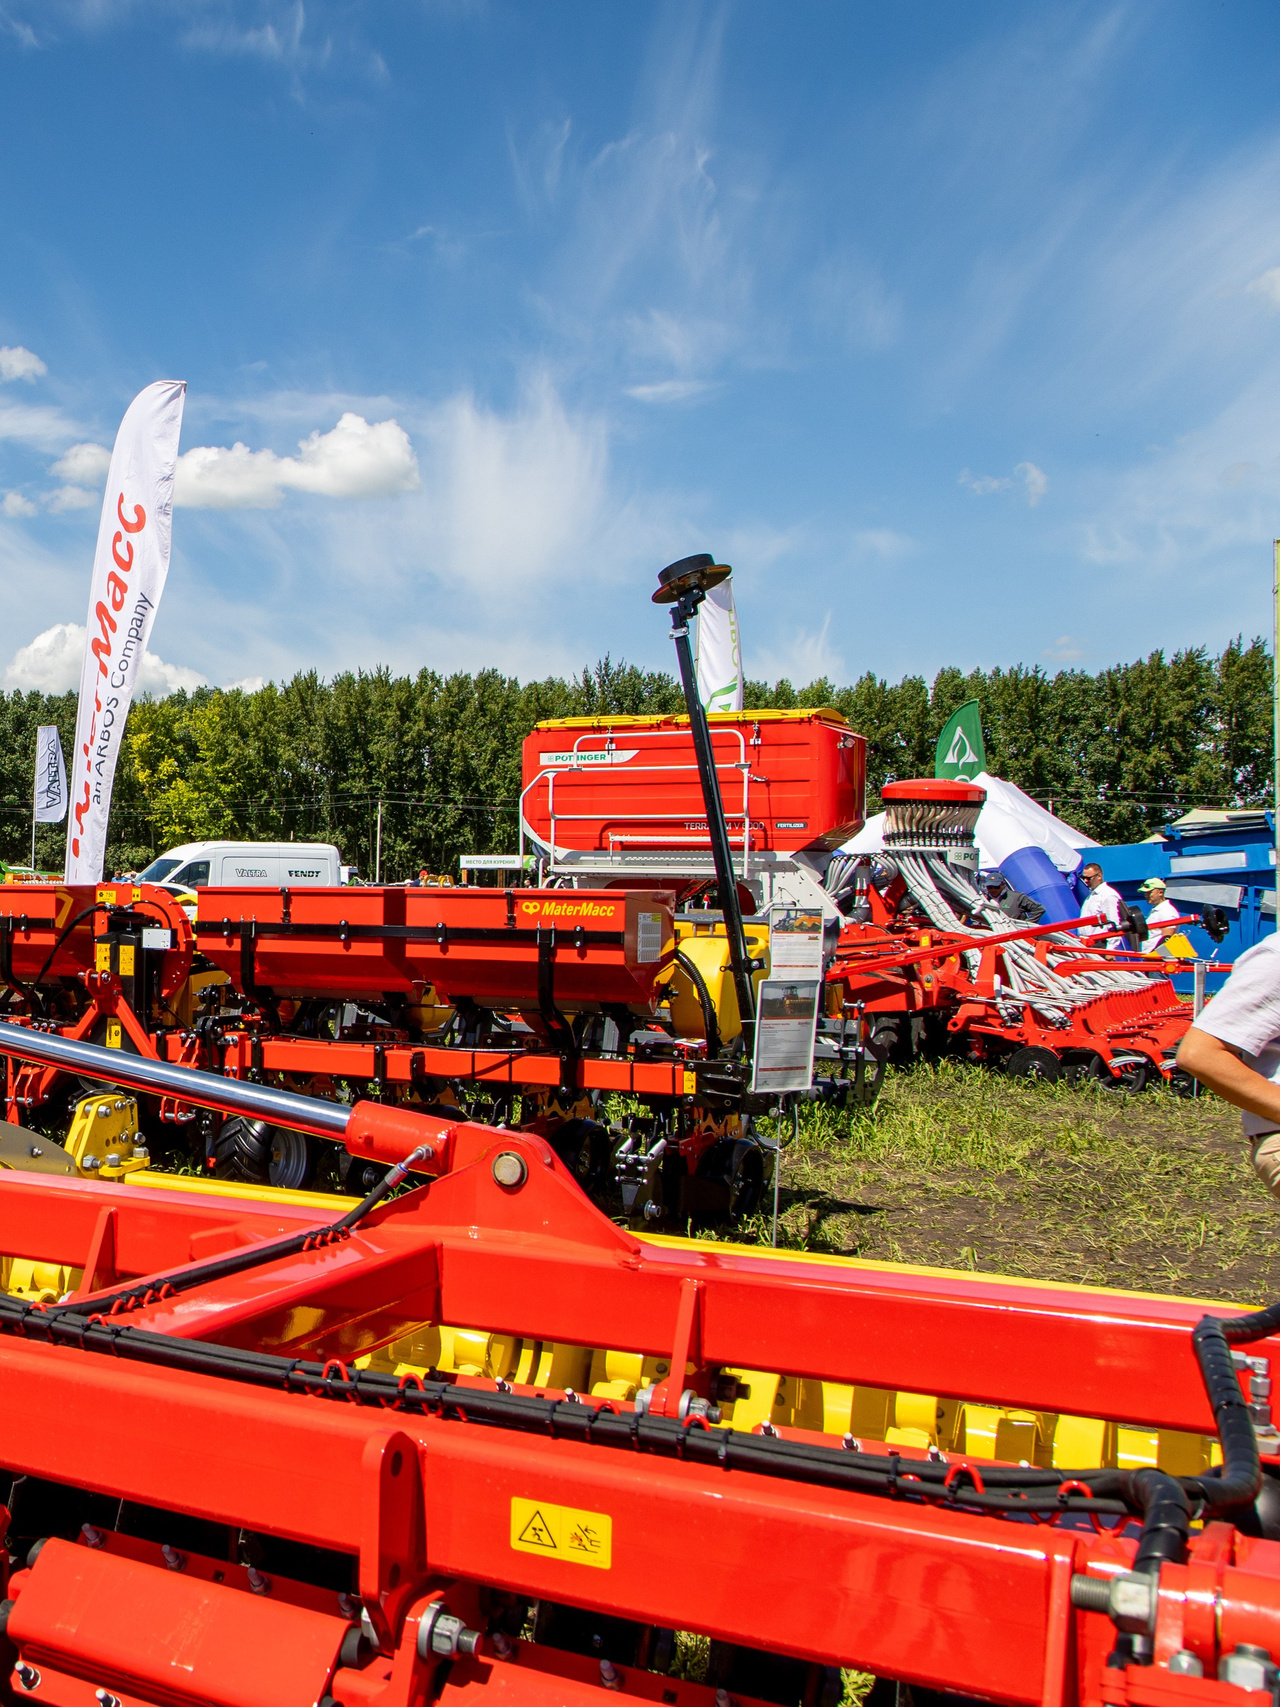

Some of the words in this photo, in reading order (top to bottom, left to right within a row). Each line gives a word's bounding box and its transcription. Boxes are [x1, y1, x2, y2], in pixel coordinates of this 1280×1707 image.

[111, 592, 154, 689] Company
[95, 697, 119, 777] ARBOS
[46, 739, 61, 808] VALTRA
[92, 782, 102, 805] an
[684, 822, 732, 830] TERRM
[235, 868, 267, 877] VALTRA
[288, 870, 321, 878] FENDT
[541, 902, 615, 917] MaterMacc
